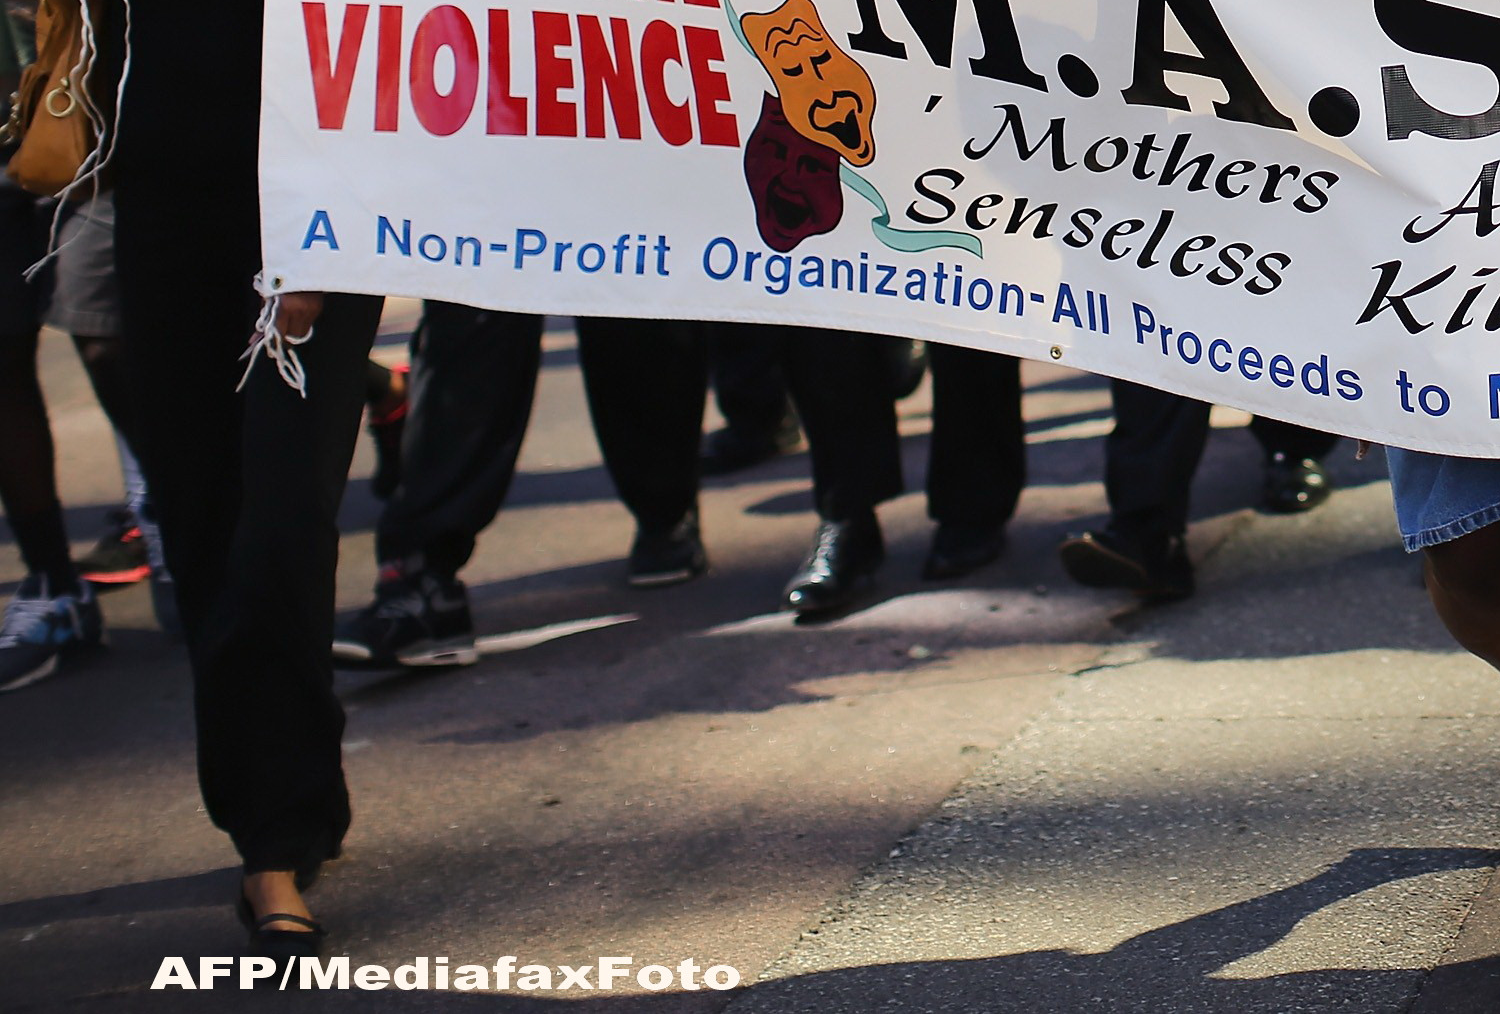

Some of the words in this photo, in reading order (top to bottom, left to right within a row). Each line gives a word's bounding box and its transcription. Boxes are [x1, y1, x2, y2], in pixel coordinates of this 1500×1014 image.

[301, 1, 741, 148] VIOLENCE
[905, 168, 1292, 296] Senseless
[301, 209, 339, 251] A
[376, 215, 671, 277] Non-Profit
[1132, 302, 1363, 401] Proceeds
[1395, 370, 1450, 417] to
